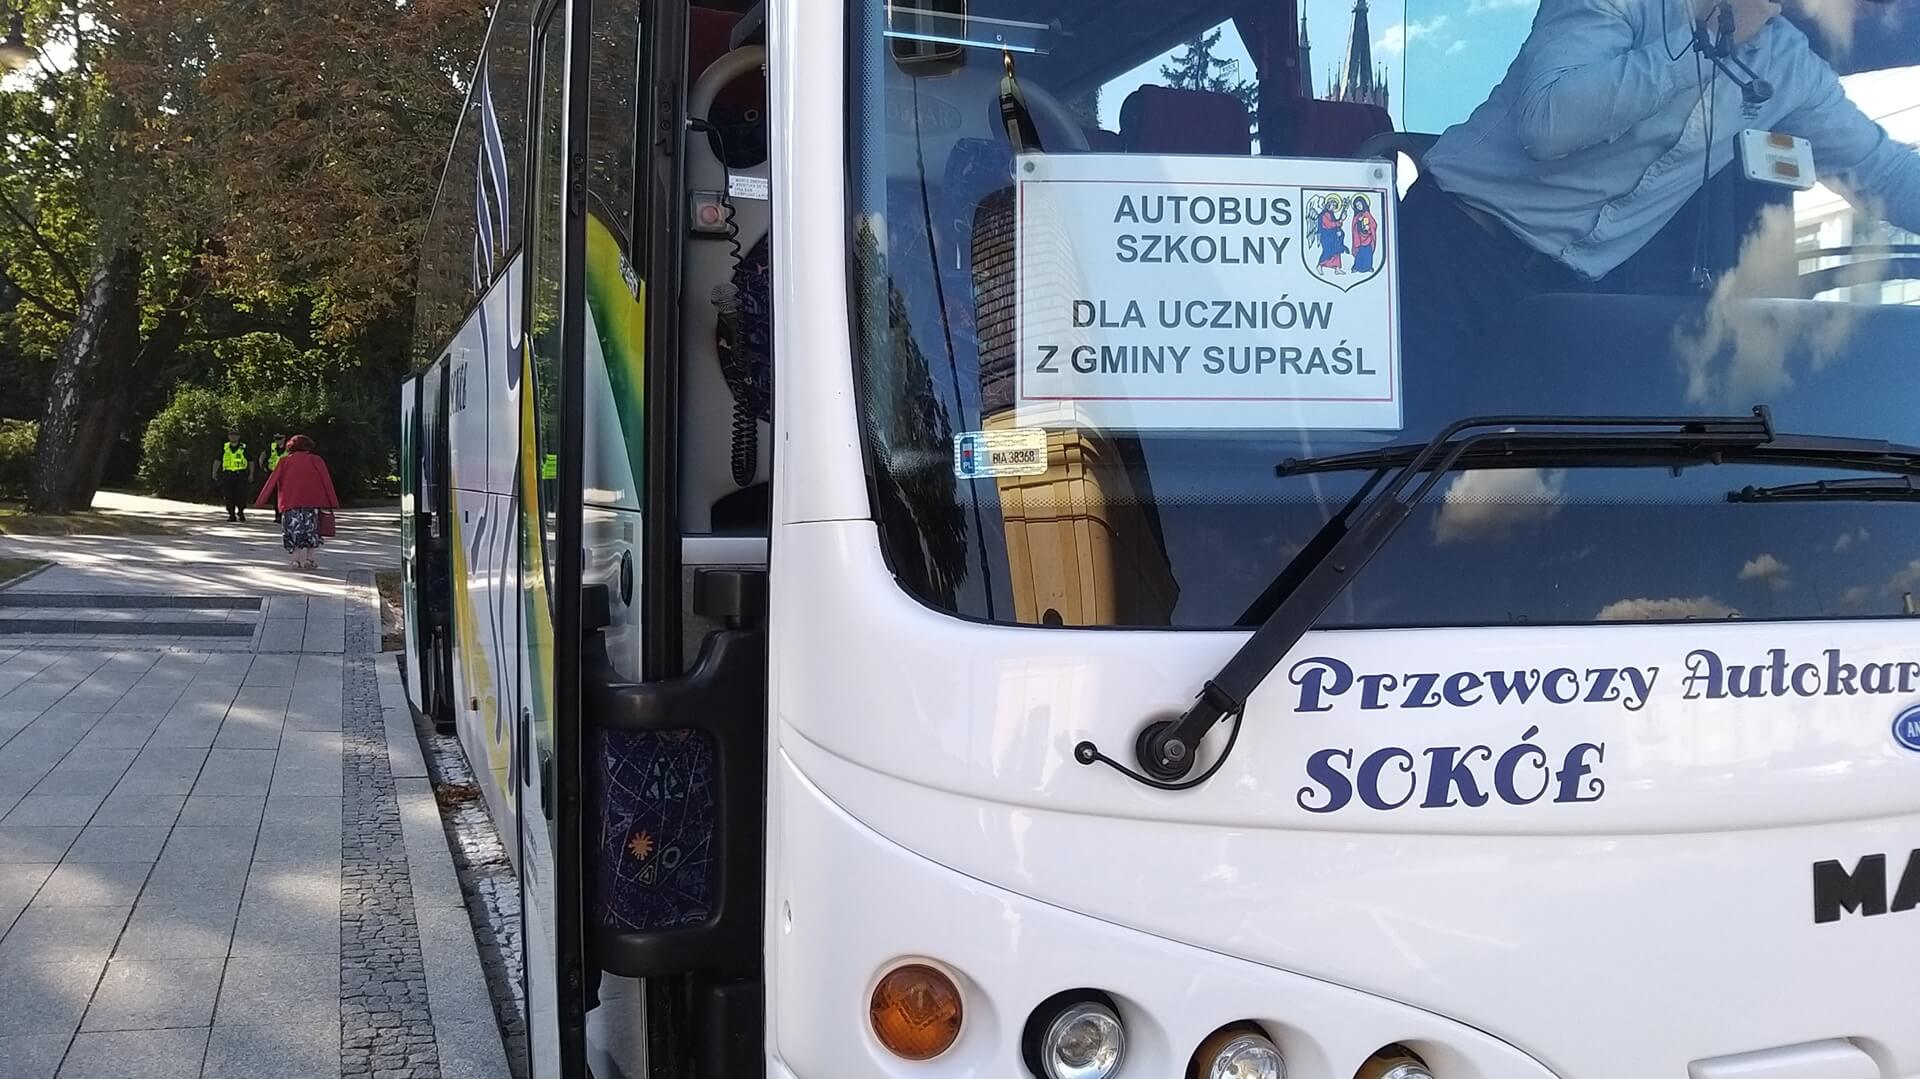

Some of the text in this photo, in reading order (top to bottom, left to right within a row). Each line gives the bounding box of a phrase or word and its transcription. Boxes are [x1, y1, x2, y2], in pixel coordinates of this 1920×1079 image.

[1113, 195, 1292, 226] AUTOBUS
[1116, 234, 1290, 264] SZKOLNY
[1072, 294, 1333, 329] DLA UCZNIÓW
[1036, 340, 1376, 375] Z GMINY SUPRAŚL
[992, 450, 1035, 464] BIA 38368
[1288, 656, 1659, 712] Przewozy
